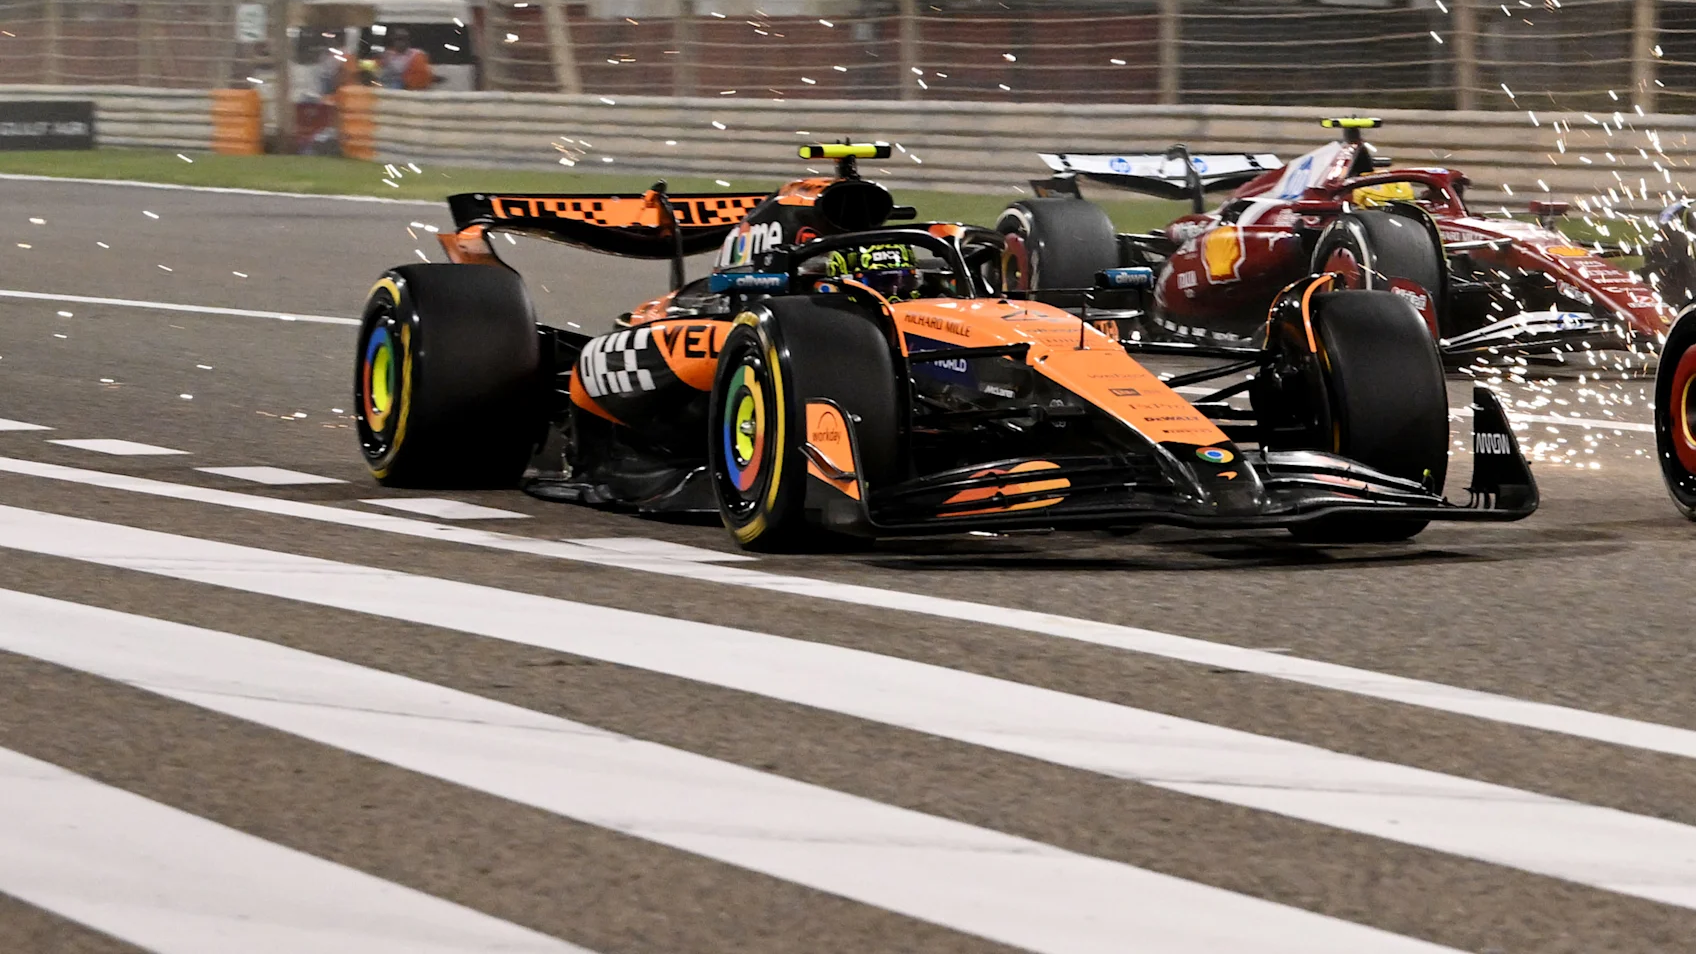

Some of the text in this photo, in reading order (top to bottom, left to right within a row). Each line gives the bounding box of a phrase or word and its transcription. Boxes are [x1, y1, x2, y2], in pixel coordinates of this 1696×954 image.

[714, 220, 783, 268] rome
[904, 313, 971, 338] RICHARD MILLE
